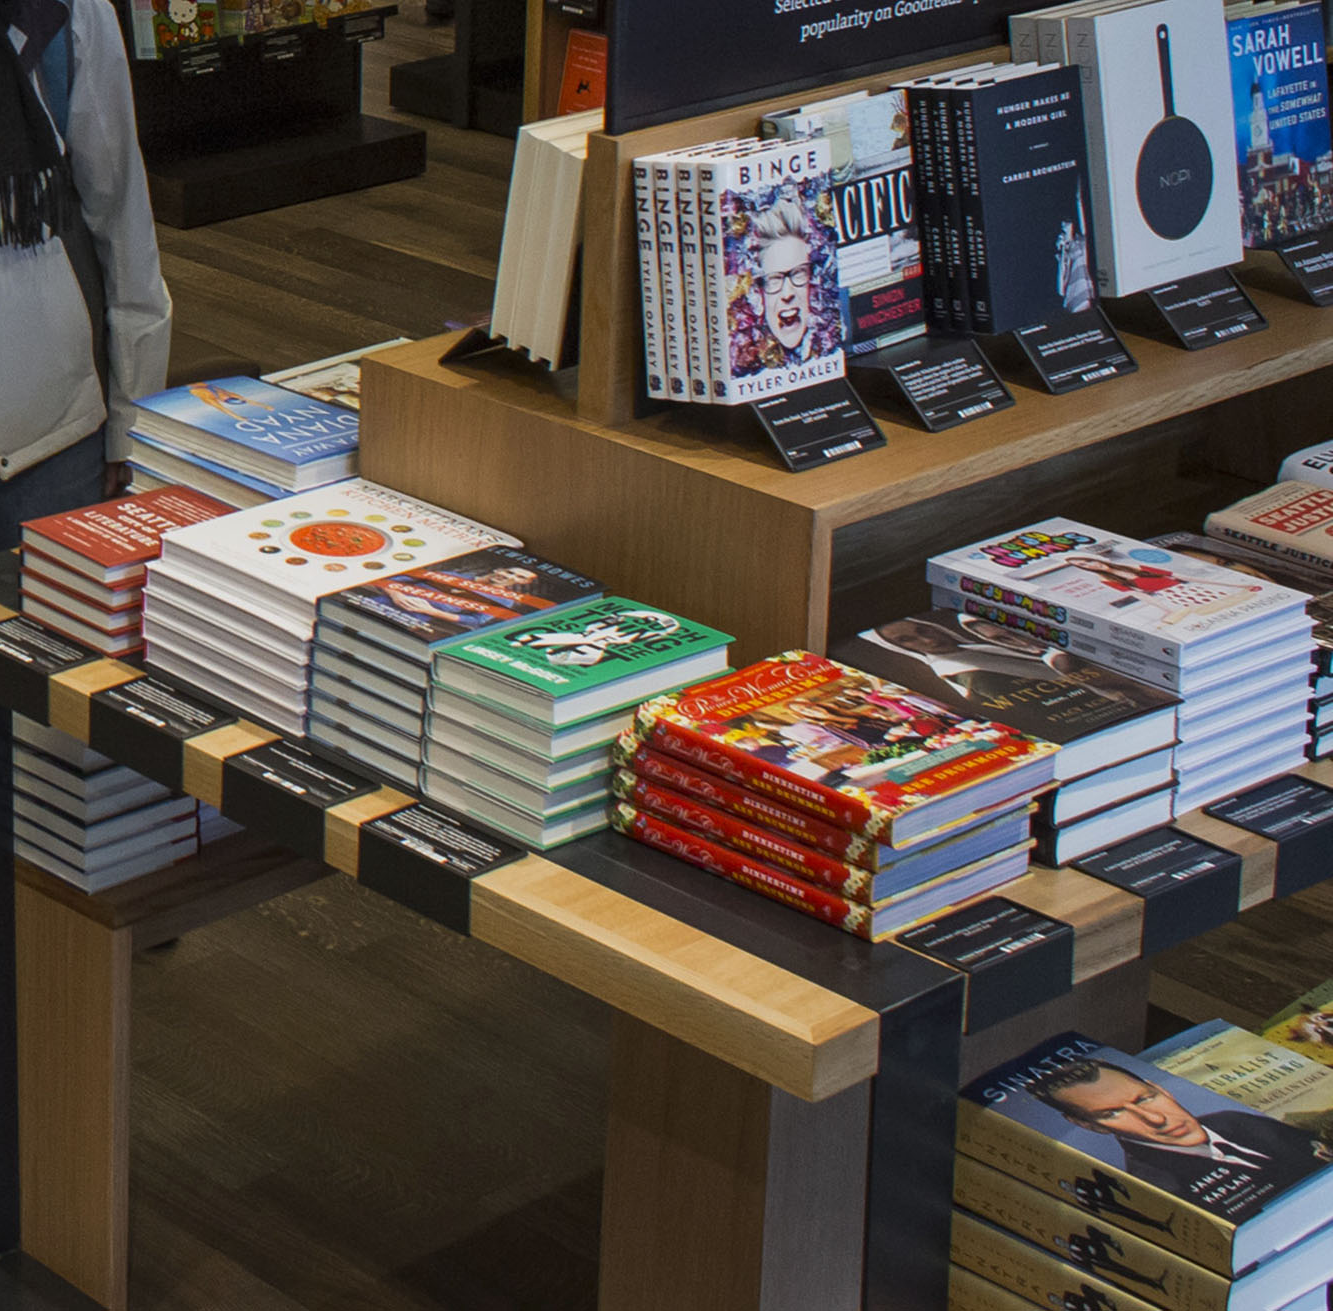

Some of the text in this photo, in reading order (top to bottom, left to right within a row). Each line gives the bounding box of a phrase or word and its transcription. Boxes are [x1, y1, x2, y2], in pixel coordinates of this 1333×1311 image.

[800, 9, 873, 43] popularity
[874, 4, 893, 21] on
[1233, 23, 1290, 57] SARAH
[1253, 42, 1324, 77] VOWELL
[739, 150, 818, 186] BINGE
[1002, 160, 1077, 184] CARRIE BROWNSTEIN
[738, 358, 841, 396] TYLER OAKLEY
[715, 673, 831, 720] DINNERTIME
[984, 1039, 1100, 1104] SINATRA
[1189, 1165, 1231, 1194] JAMES
[1201, 1174, 1252, 1205] KAPLAN
